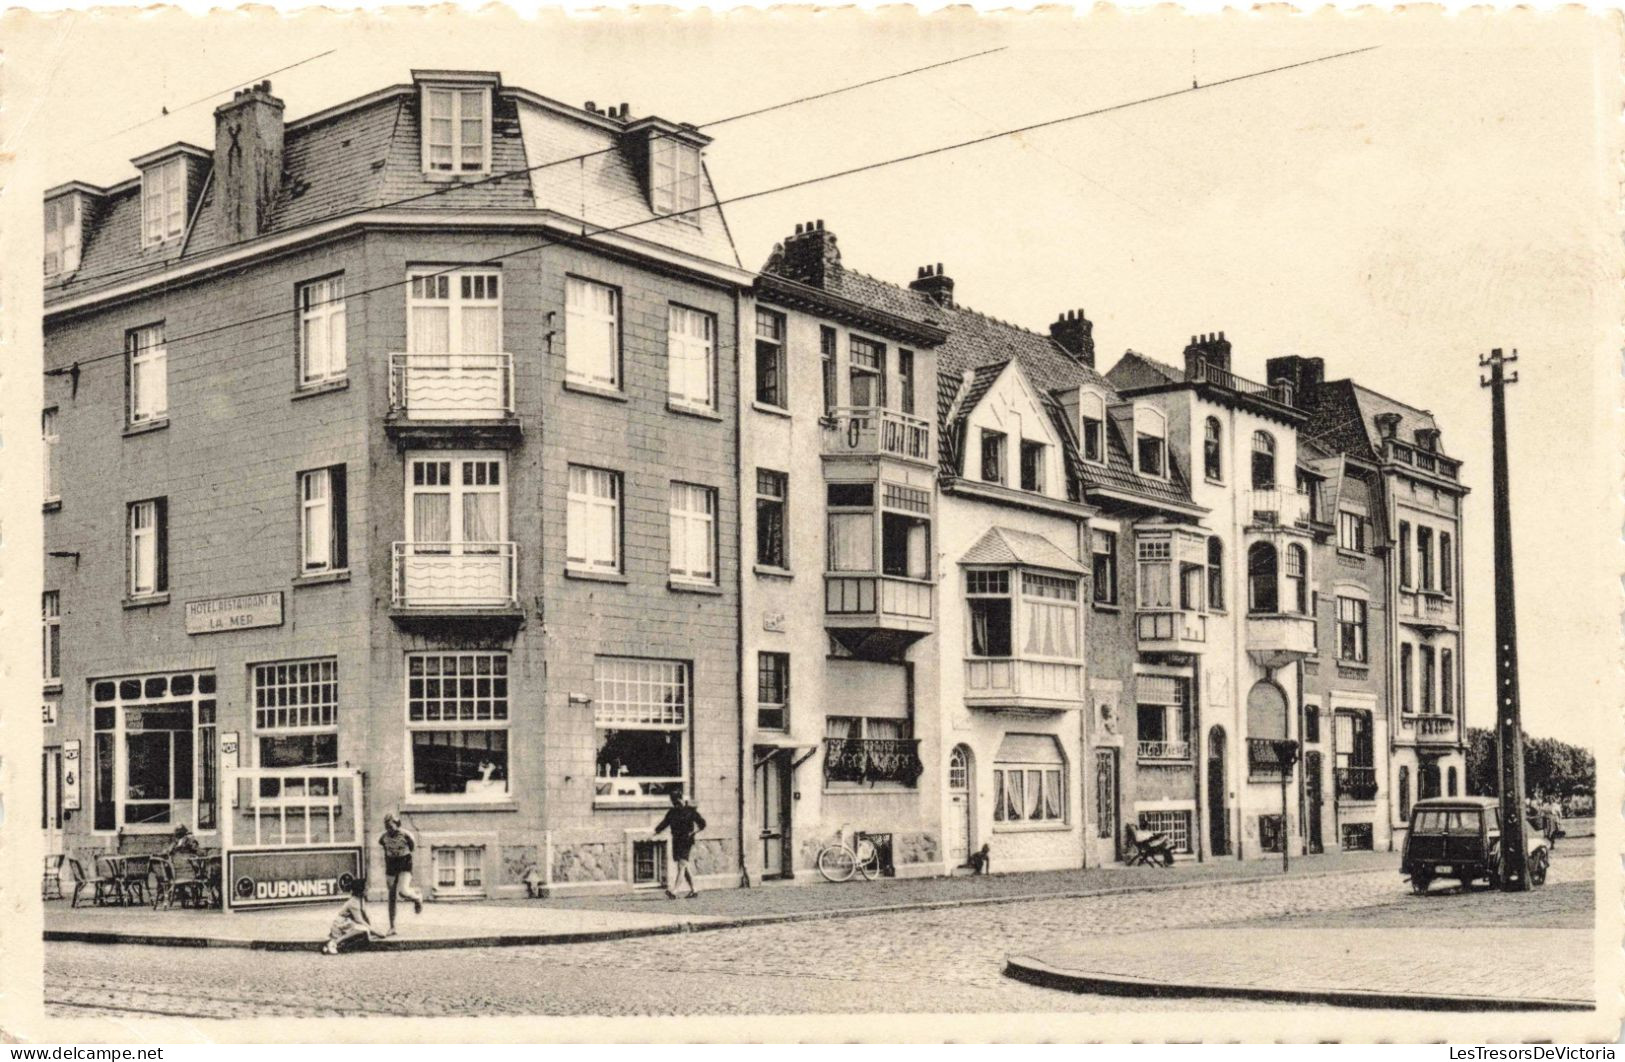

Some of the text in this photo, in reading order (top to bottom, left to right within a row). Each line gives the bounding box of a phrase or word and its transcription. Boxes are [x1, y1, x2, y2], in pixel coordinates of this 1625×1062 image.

[210, 618, 223, 629] LA
[230, 614, 253, 627] MER
[256, 878, 337, 899] DUBONNET
